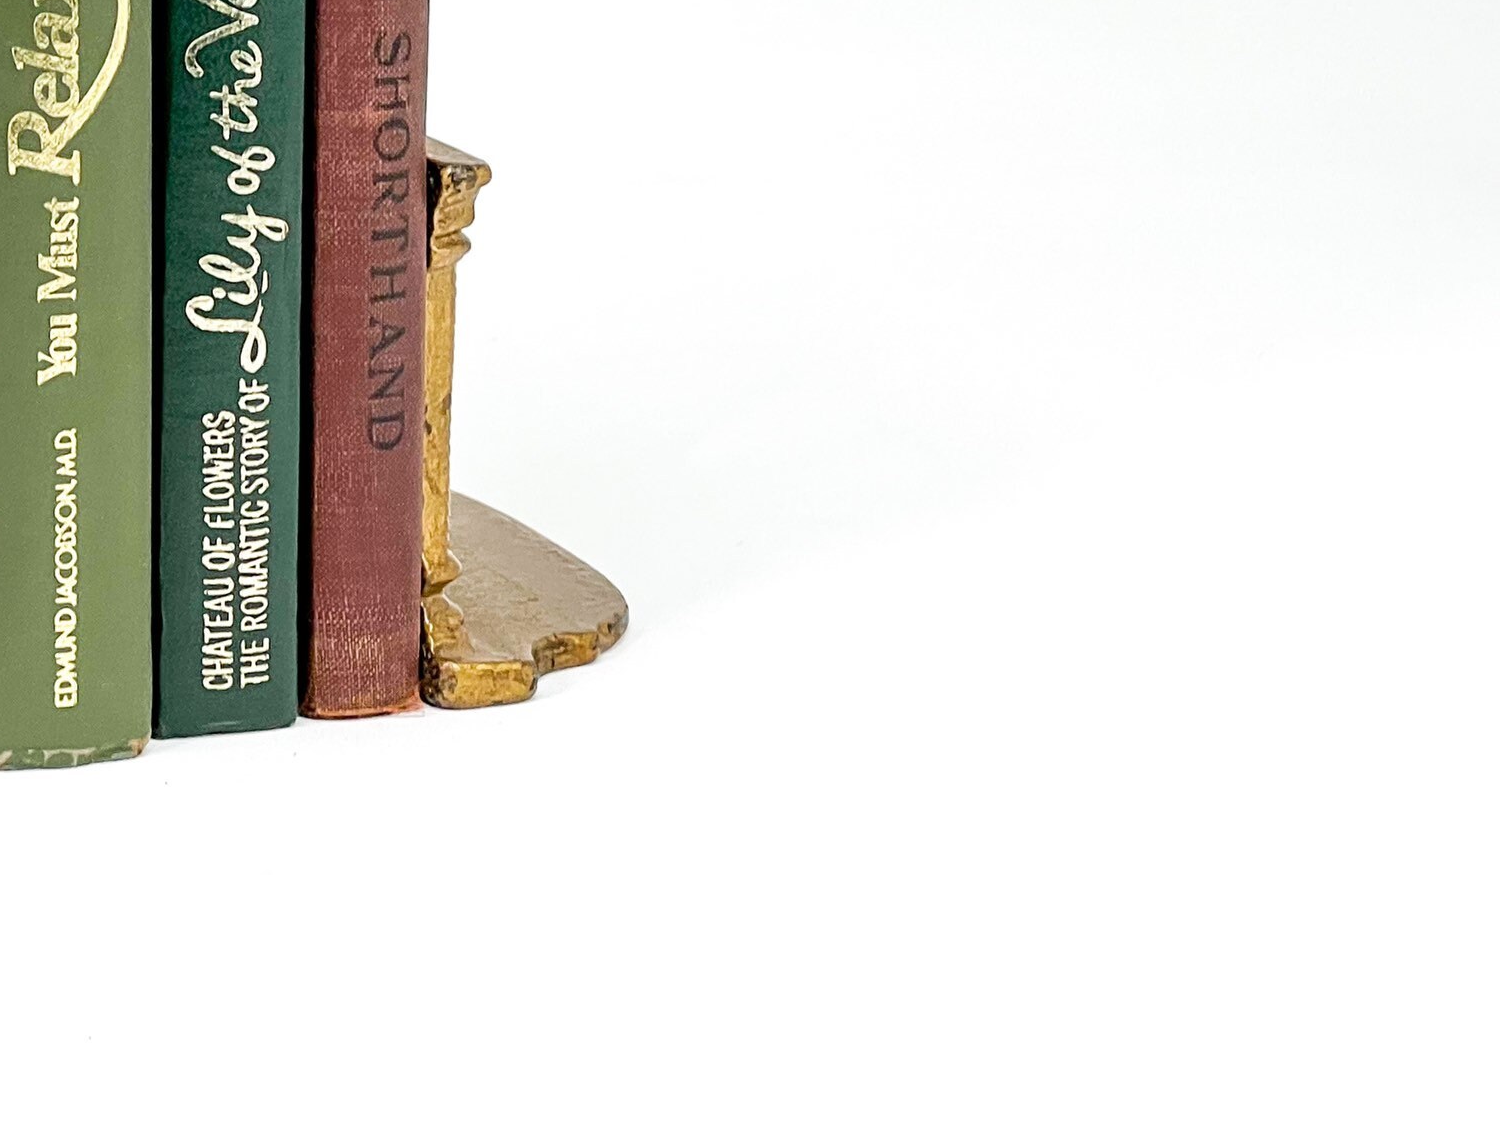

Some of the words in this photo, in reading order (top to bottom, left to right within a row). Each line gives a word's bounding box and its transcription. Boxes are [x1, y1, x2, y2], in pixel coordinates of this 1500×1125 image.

[209, 39, 263, 141] the
[210, 145, 276, 196] of
[36, 196, 79, 303] Must
[185, 203, 289, 374] Lily
[366, 31, 411, 451] SHORTHAND
[36, 312, 78, 386] You
[238, 377, 270, 413] OF
[201, 409, 236, 529] FLOWERS
[238, 416, 270, 495] STORY
[201, 535, 236, 572] OF
[238, 499, 270, 631] ROMANTIC
[53, 607, 78, 708] EDMUND
[201, 576, 235, 691] CHATEAU
[239, 637, 270, 689] THE
